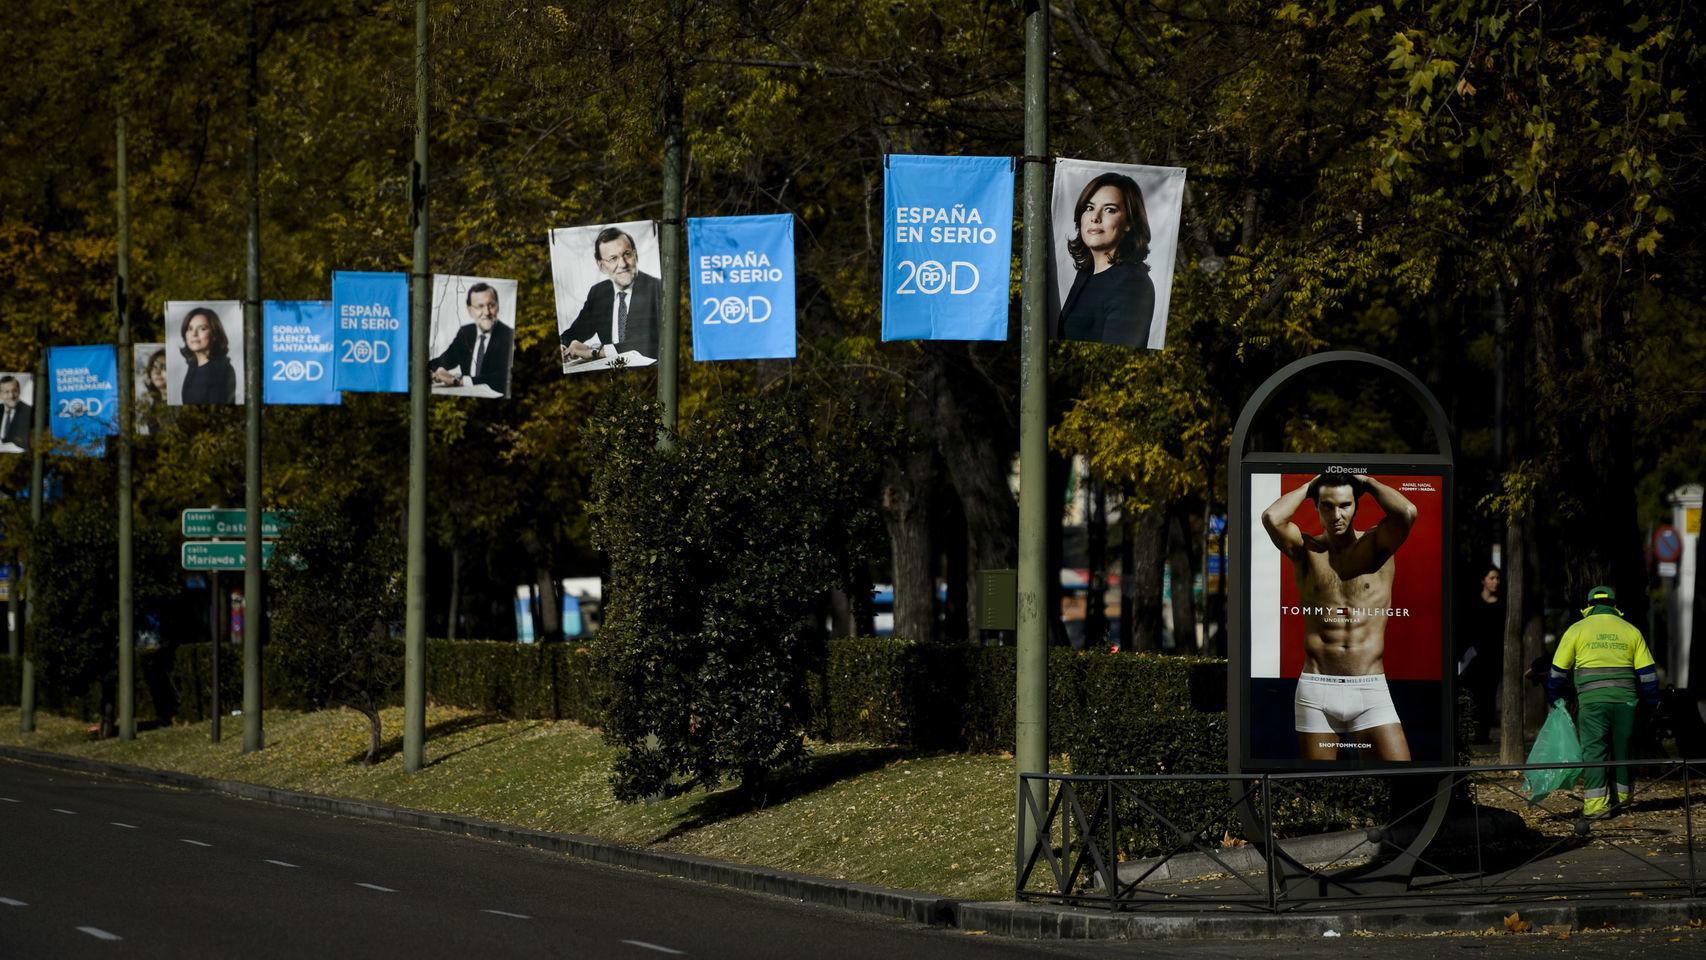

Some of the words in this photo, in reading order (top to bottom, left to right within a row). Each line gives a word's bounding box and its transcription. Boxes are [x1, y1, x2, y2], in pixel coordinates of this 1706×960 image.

[896, 203, 983, 224] ESPAÑA
[896, 226, 923, 243] EN
[930, 227, 997, 245] SERIO
[700, 250, 771, 269] ESPAÑA
[701, 270, 725, 285] EN
[729, 268, 783, 283] SERIO
[341, 303, 391, 317] ESPAÑA
[272, 325, 312, 334] SORAYA
[341, 318, 358, 330] EN
[361, 318, 400, 331] SERIO
[307, 334, 321, 344] DE
[1325, 465, 1368, 474] JCDecaux
[186, 512, 215, 521] lateral
[187, 546, 208, 554] calle
[1281, 606, 1333, 616] TOMMY
[1352, 607, 1410, 617] HILFIGER
